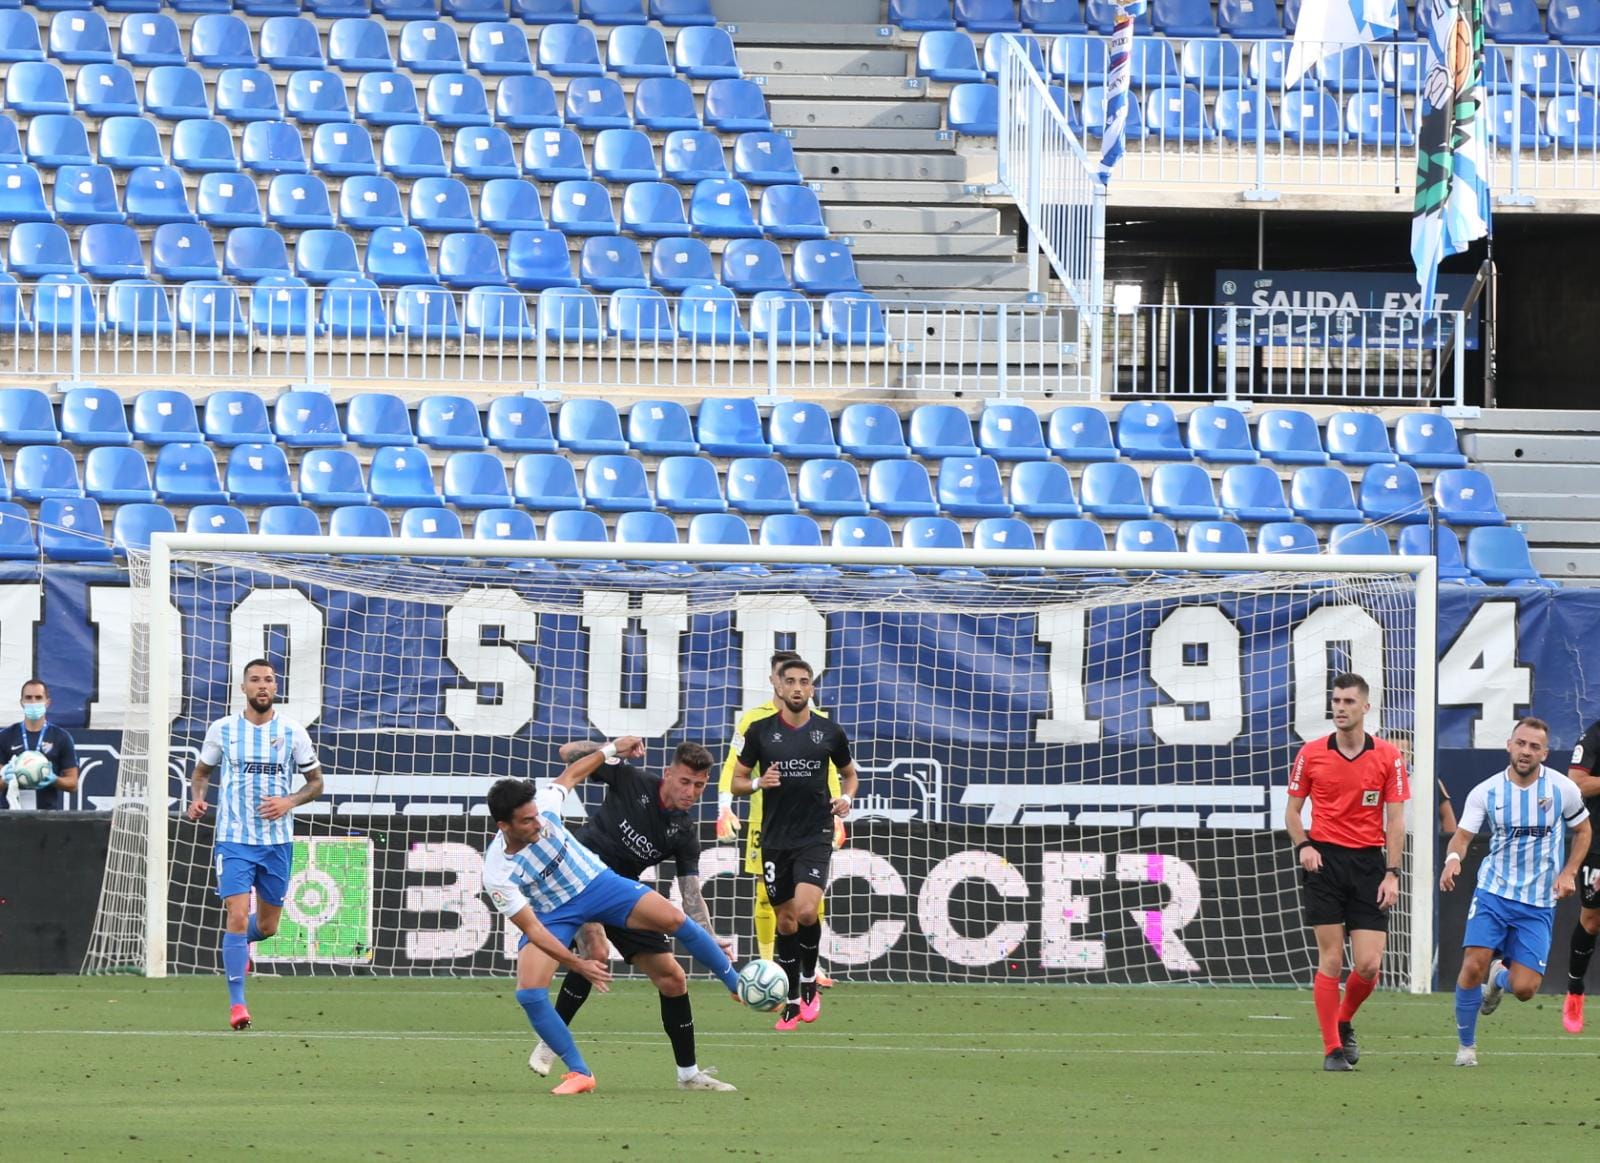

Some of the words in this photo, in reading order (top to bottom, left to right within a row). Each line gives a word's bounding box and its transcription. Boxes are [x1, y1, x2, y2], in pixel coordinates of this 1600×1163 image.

[727, 25, 736, 33] 13
[880, 27, 889, 35] 13
[909, 80, 918, 88] 12
[939, 132, 948, 140] 11
[1251, 289, 1361, 317] SALIDA
[1384, 292, 1449, 319] EXT
[446, 588, 829, 738] SUR
[1035, 602, 1531, 748] 1904
[243, 762, 285, 774] TESESA
[764, 860, 776, 882] 3
